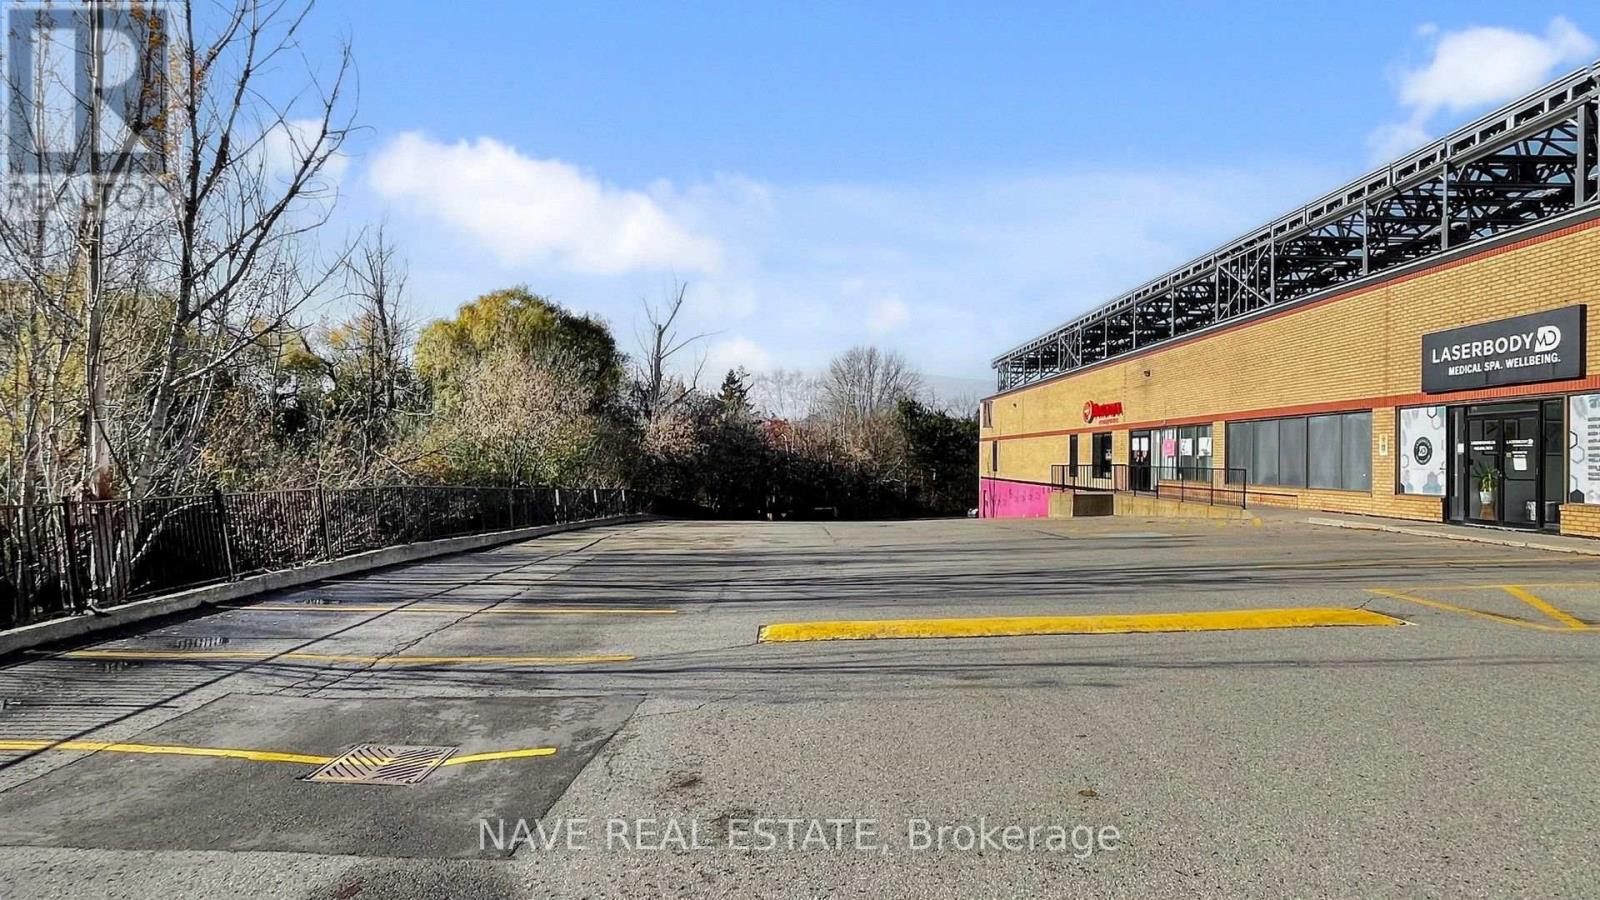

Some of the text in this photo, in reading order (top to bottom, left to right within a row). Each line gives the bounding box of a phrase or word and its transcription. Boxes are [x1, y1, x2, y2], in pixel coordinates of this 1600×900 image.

[1448, 352, 1561, 376] MEDICAL SPA. WELLBEING.
